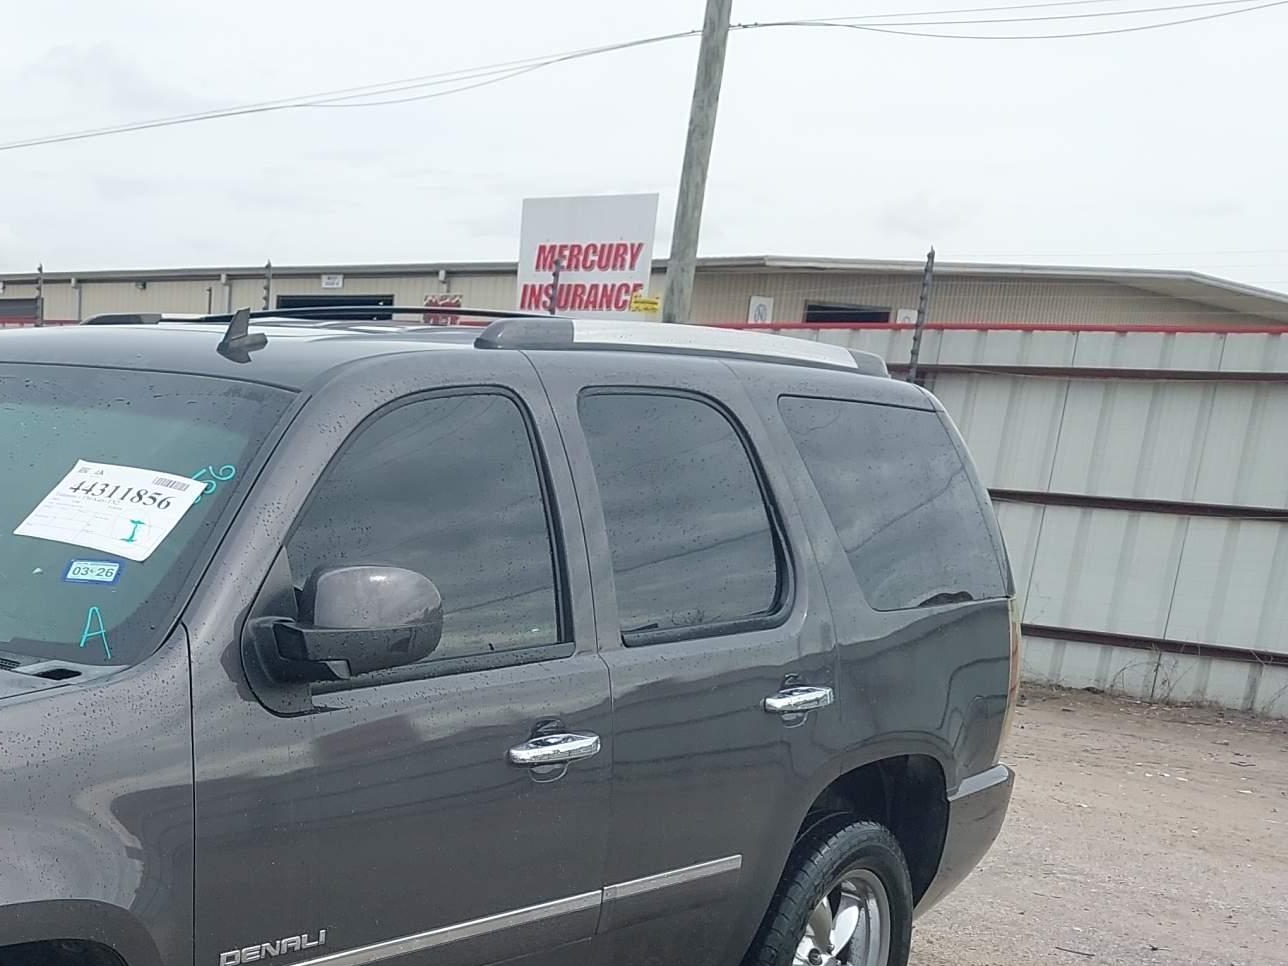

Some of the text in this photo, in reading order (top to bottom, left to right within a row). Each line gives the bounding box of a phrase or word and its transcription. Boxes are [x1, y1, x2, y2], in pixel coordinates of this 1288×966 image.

[535, 242, 644, 272] MERCURY
[69, 480, 176, 510] 44311856
[72, 566, 115, 578] 03 26
[79, 606, 111, 660] A
